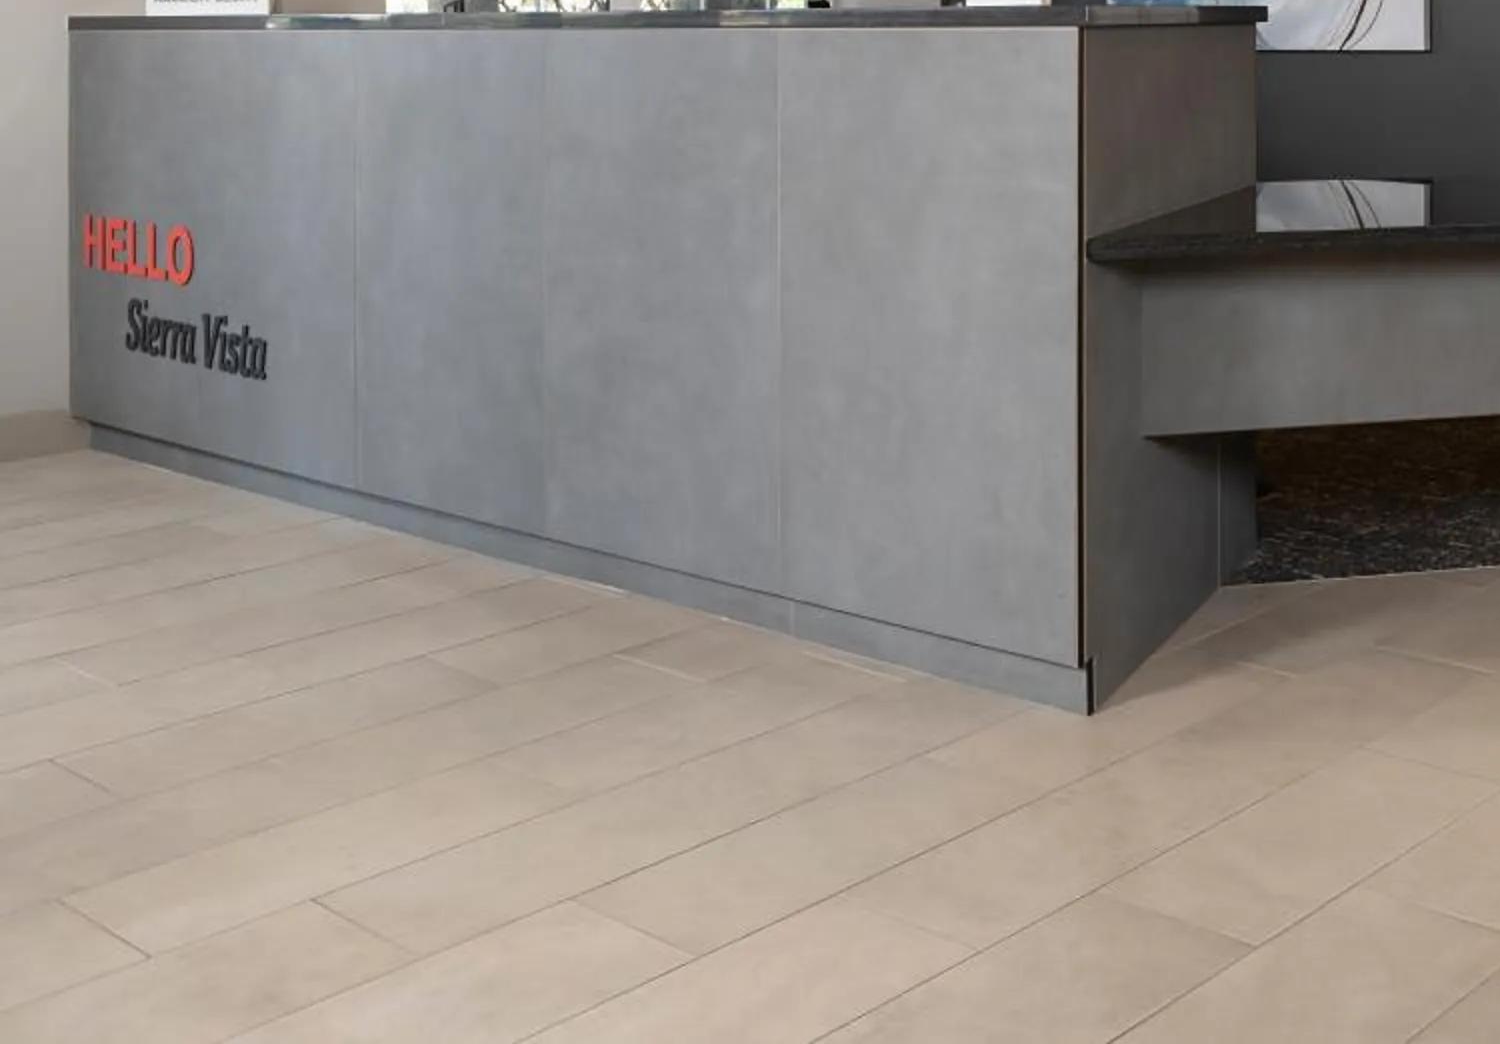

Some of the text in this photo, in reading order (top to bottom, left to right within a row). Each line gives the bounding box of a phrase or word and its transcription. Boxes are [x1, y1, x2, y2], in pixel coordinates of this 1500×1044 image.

[83, 213, 195, 287] HELLO
[125, 297, 267, 381] Sierra Vista
